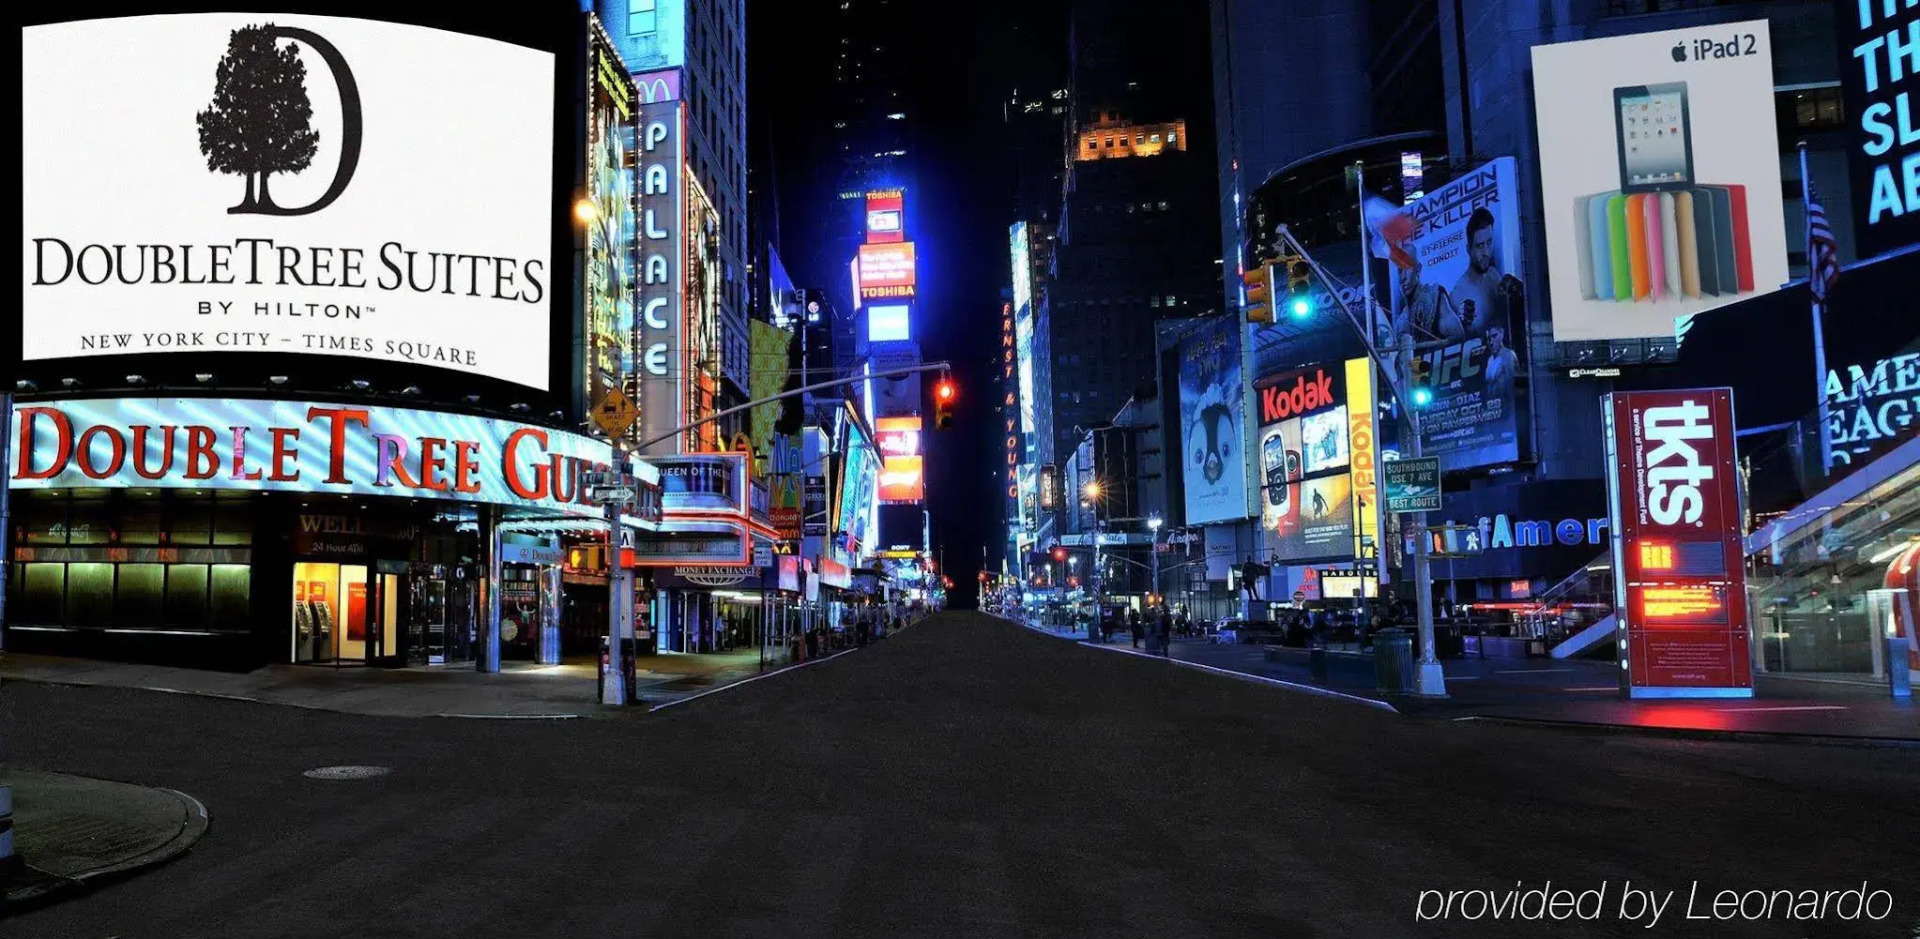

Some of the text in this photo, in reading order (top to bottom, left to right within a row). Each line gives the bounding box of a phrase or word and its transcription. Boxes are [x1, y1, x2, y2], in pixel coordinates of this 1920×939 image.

[1693, 34, 1757, 61] iPad 2
[866, 191, 902, 200] TOSHIBA
[1429, 189, 1500, 234] KILLER
[644, 120, 668, 376] PALACE
[1427, 247, 1460, 267] CONDIT
[861, 286, 915, 298] TOSHIBA
[198, 301, 233, 316] BY
[81, 334, 133, 350] NEW
[143, 332, 205, 348] YORK
[216, 332, 271, 347] CITY
[302, 333, 374, 353] TIMES
[386, 342, 478, 367] SQUARE
[1262, 371, 1333, 423] Kodak
[1350, 412, 1375, 508] Kodak
[1387, 461, 1437, 474] SOUTHBOUND
[1642, 400, 1714, 527] tkts
[660, 466, 687, 477] UEEN
[1391, 472, 1432, 484] USE 7 AVE
[1636, 469, 1646, 508] Development
[1389, 497, 1437, 509] BEST ROUTE
[1639, 508, 1648, 525] Fund
[312, 541, 324, 552] 24
[326, 542, 346, 553] Hour
[674, 567, 707, 575] MONEY
